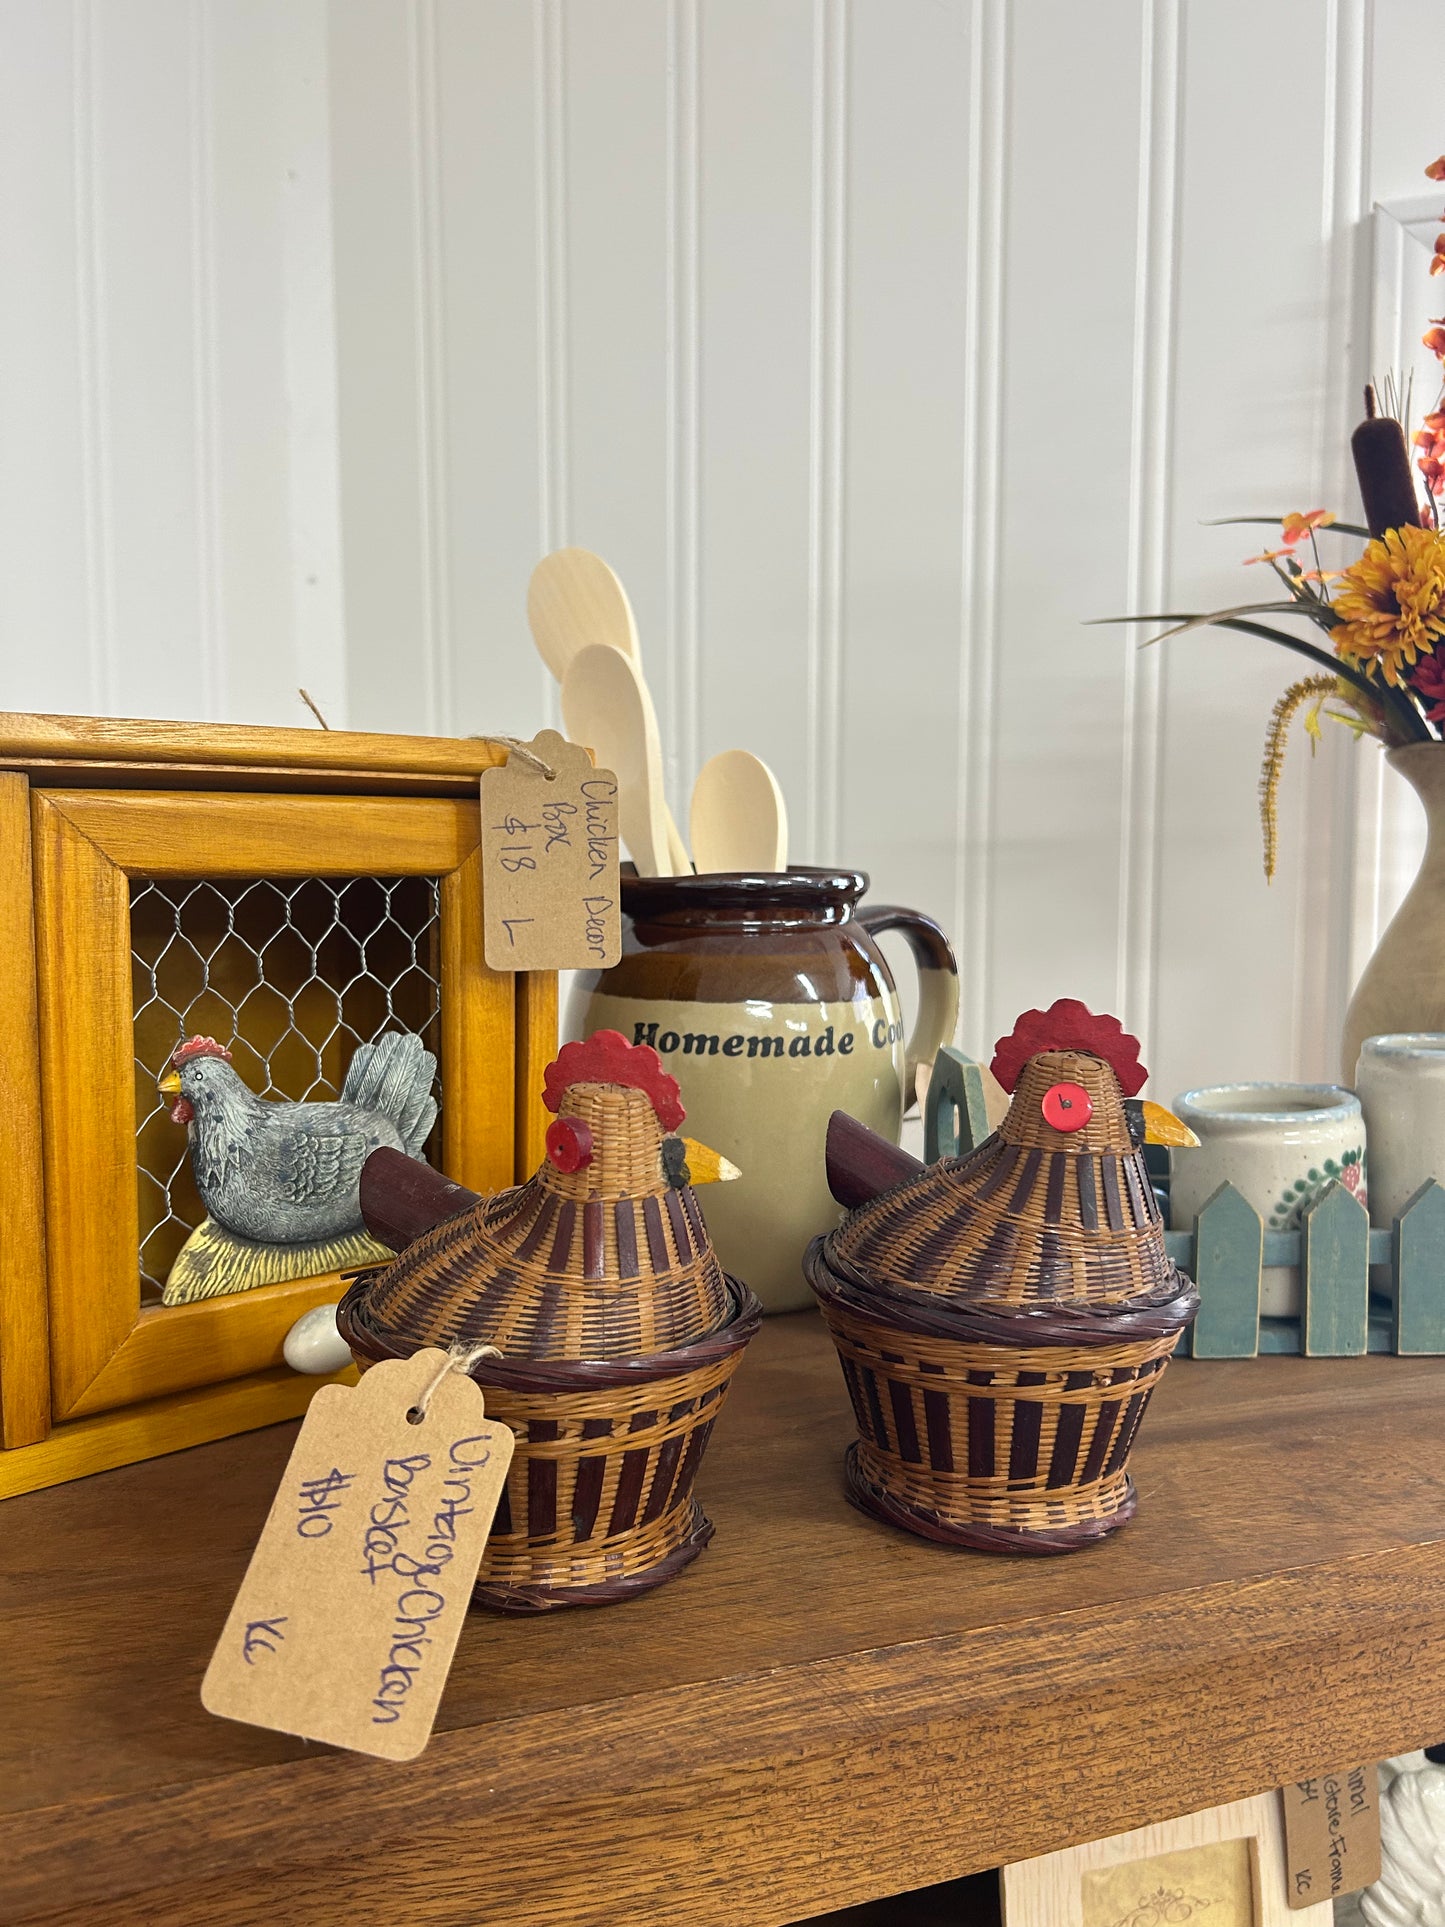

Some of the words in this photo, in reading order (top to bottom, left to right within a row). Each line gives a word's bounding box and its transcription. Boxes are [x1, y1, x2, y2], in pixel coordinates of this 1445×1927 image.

[491, 813, 542, 873] $18
[542, 802, 578, 854] Box
[581, 780, 618, 881] Chicken
[582, 896, 614, 959] Decor
[633, 1022, 854, 1058] Homemade
[872, 1019, 904, 1049] Coo
[296, 1467, 357, 1538] $10
[360, 1453, 432, 1585] Basket
[372, 1589, 445, 1724] Chicken
[1328, 1834, 1347, 1895] Frame
